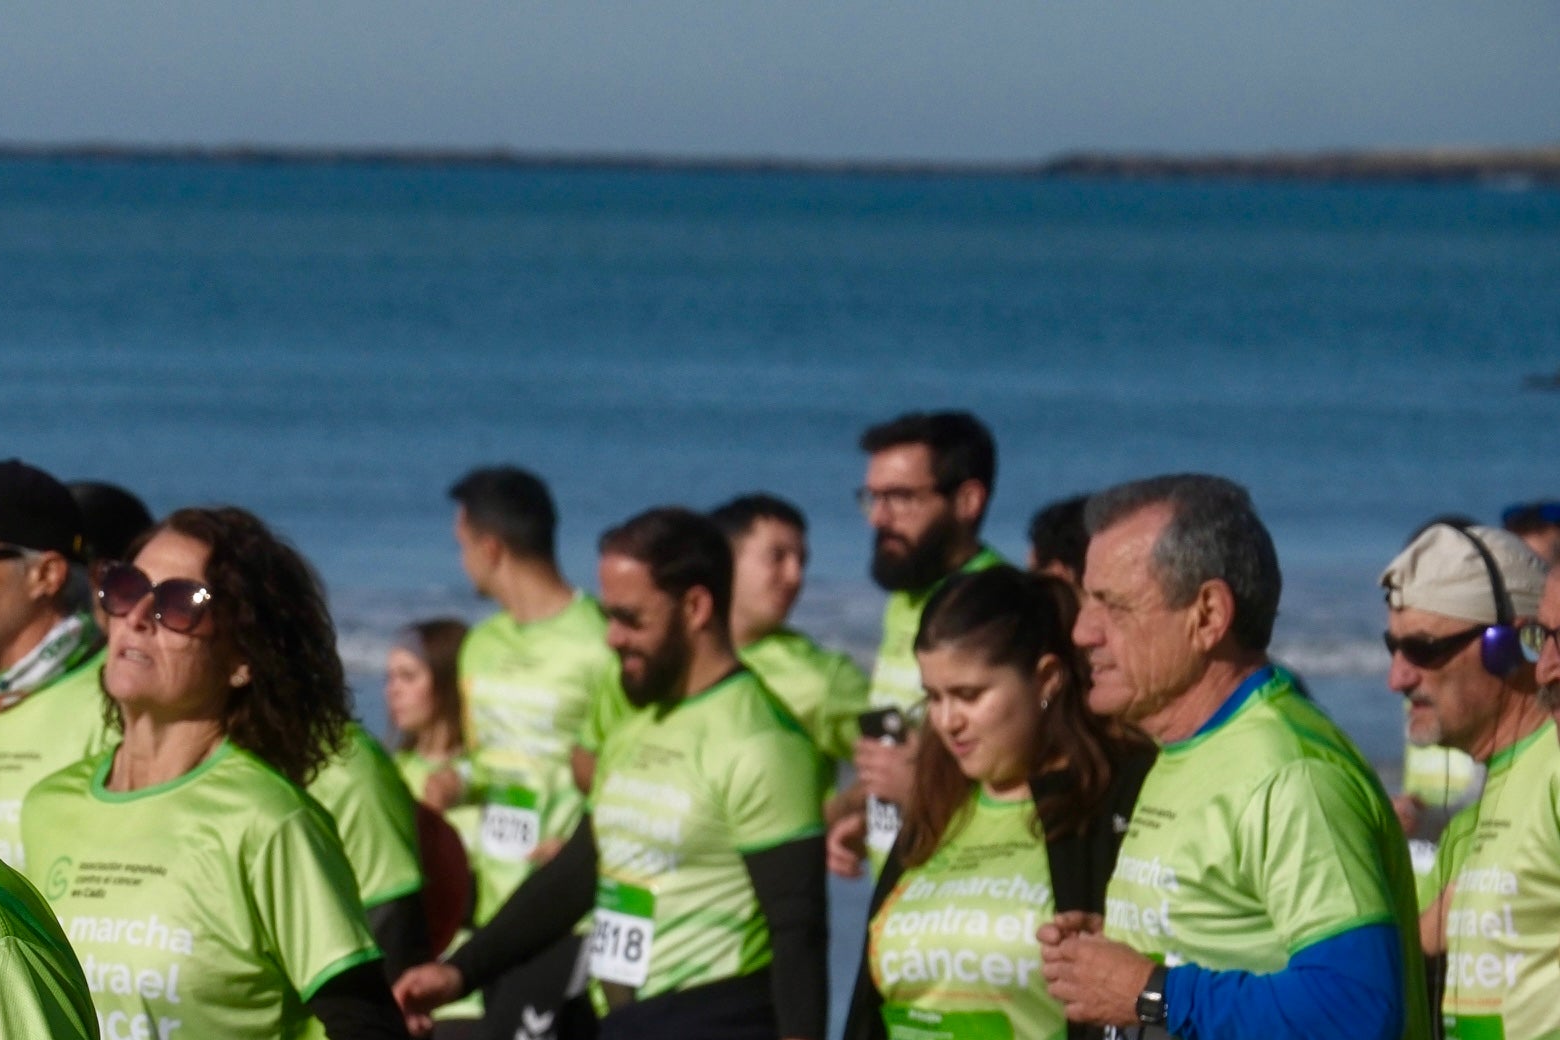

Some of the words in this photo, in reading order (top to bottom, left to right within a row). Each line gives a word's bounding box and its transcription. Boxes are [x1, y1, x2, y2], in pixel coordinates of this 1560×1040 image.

[70, 914, 194, 956] marcha
[883, 903, 988, 938] contra
[995, 909, 1038, 946] el
[83, 954, 133, 994] tra
[137, 963, 182, 1004] el
[880, 937, 1039, 988] cáncer
